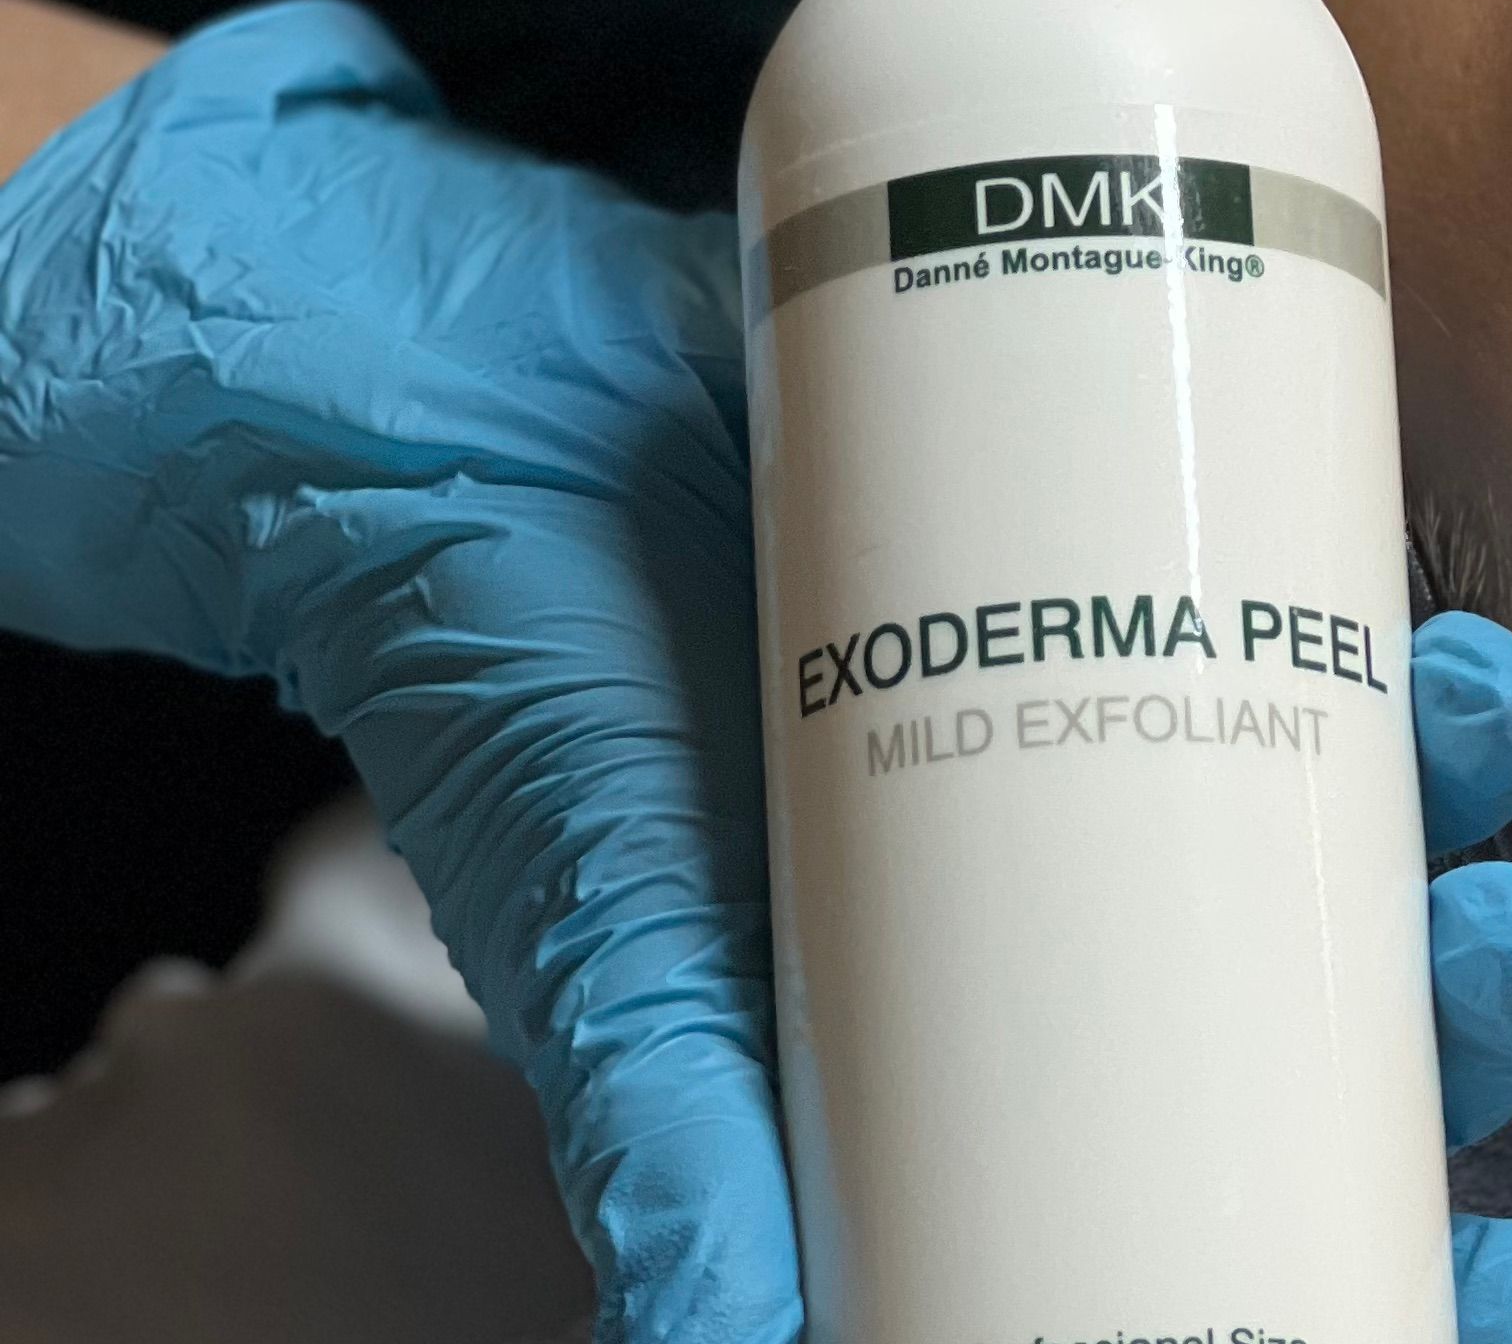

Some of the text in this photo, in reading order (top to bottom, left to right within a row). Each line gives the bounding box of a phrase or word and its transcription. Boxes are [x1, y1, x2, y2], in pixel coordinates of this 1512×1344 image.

[974, 170, 1180, 236] DMK
[893, 251, 990, 294] Danné
[799, 594, 1388, 718] EXODERMA PEEL
[865, 693, 1330, 778] MILD EXFOLIANT
